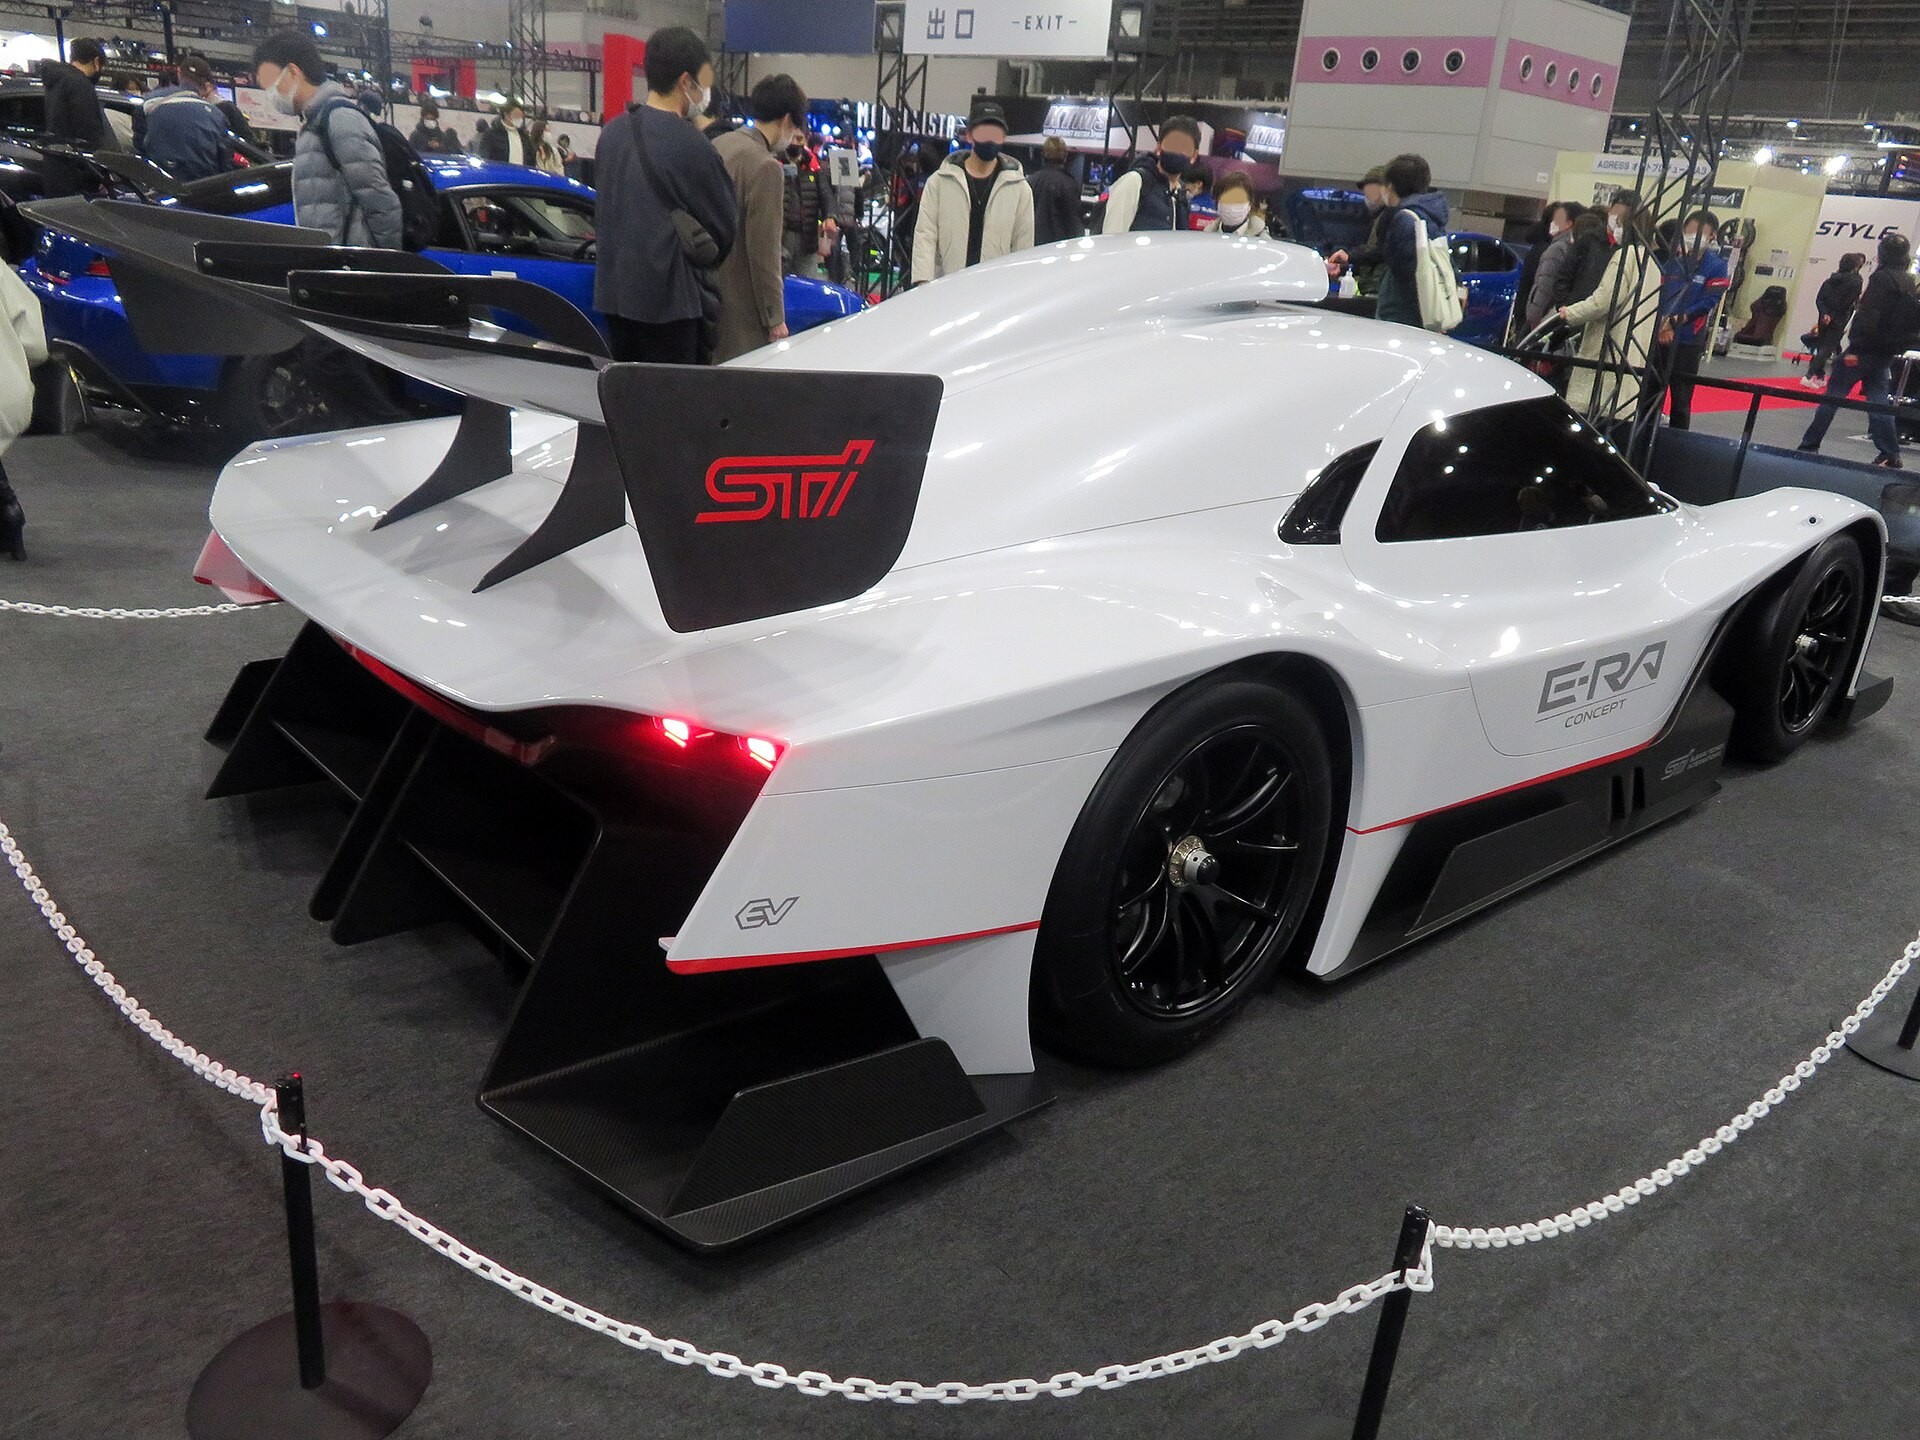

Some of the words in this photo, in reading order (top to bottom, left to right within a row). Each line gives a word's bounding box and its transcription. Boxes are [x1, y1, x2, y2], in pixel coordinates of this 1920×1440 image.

[927, 7, 975, 40] 出口
[1537, 640, 1667, 714] E-RA
[1564, 698, 1627, 728] CONCEPT
